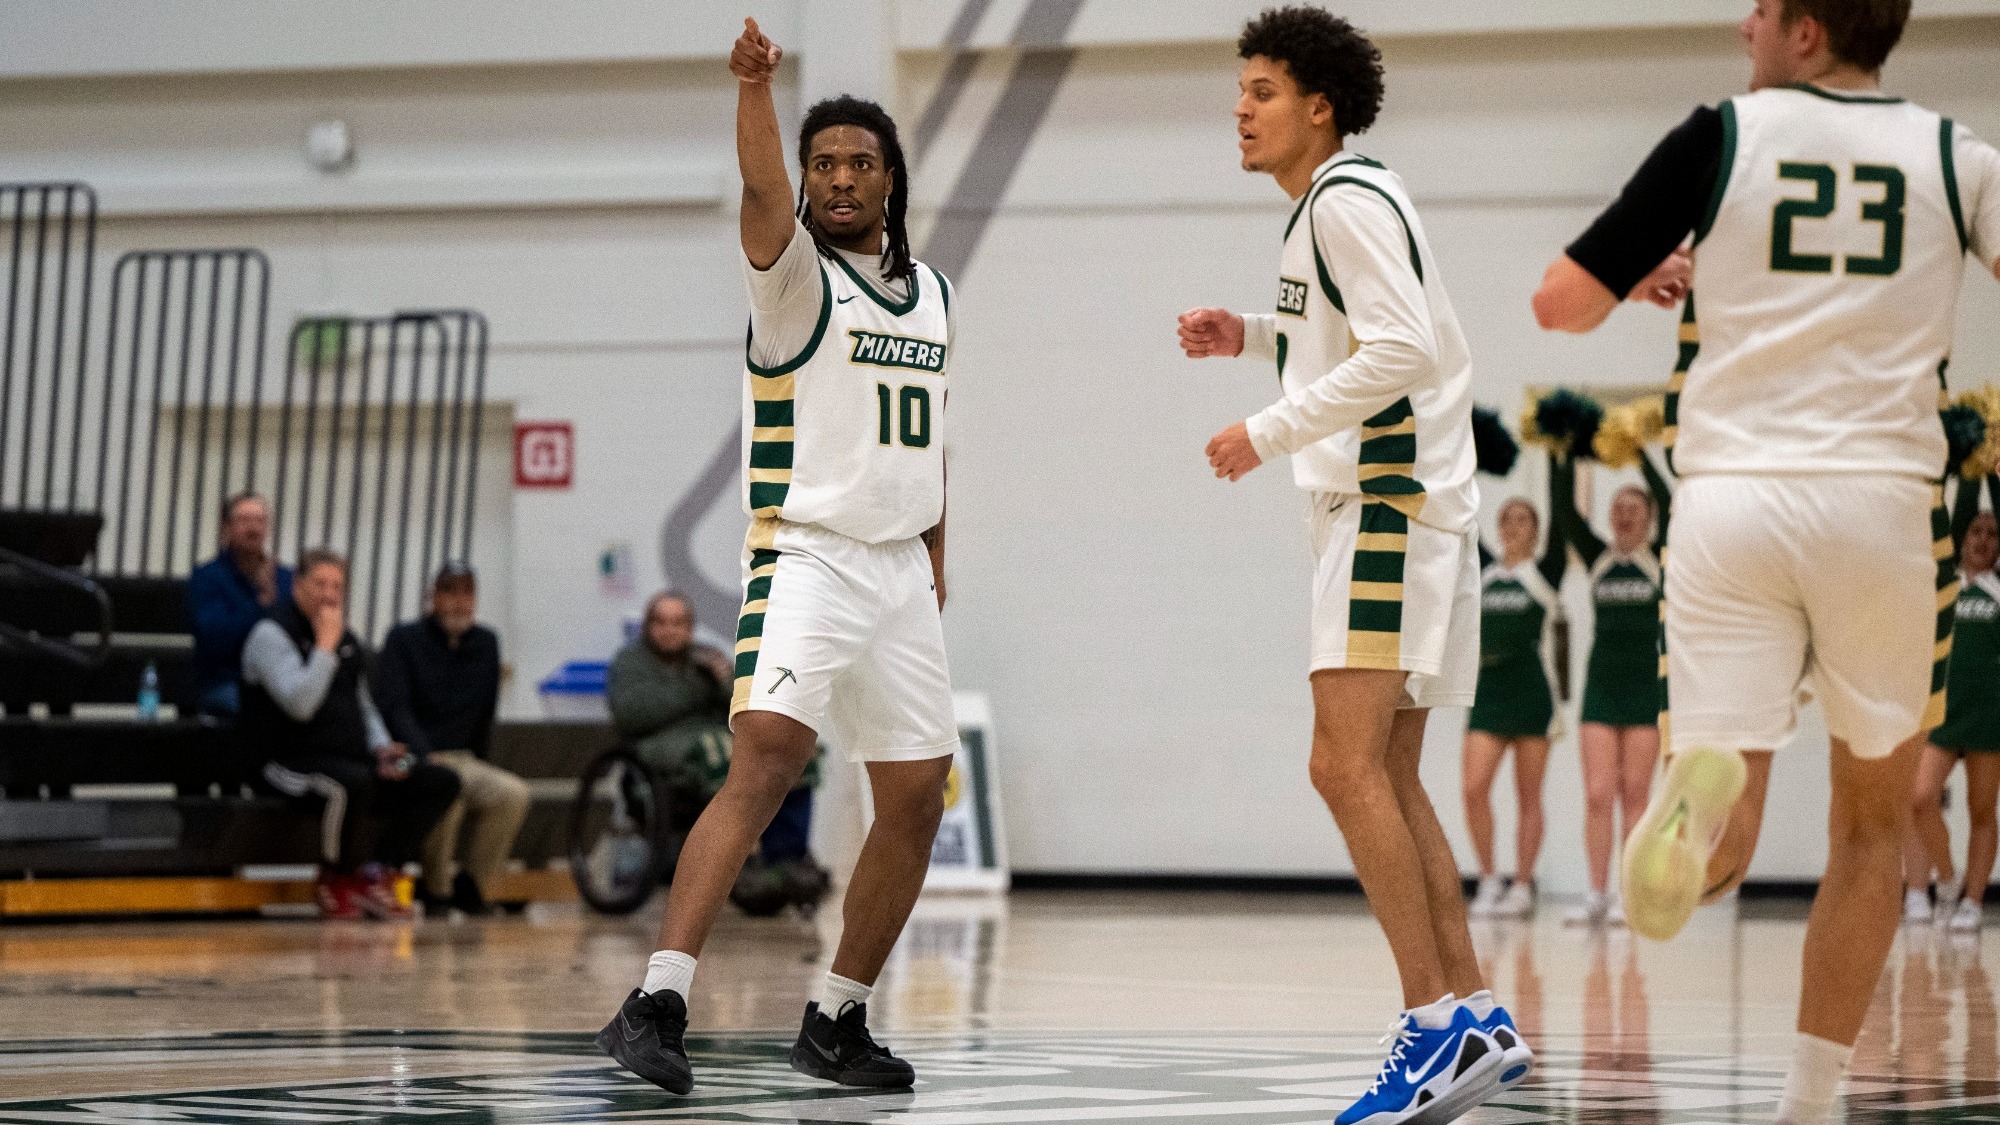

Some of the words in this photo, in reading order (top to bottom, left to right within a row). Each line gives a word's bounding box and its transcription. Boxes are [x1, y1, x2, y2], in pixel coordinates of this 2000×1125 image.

[1769, 161, 1905, 276] 23
[855, 333, 942, 368] MINERS
[877, 382, 931, 450] 10
